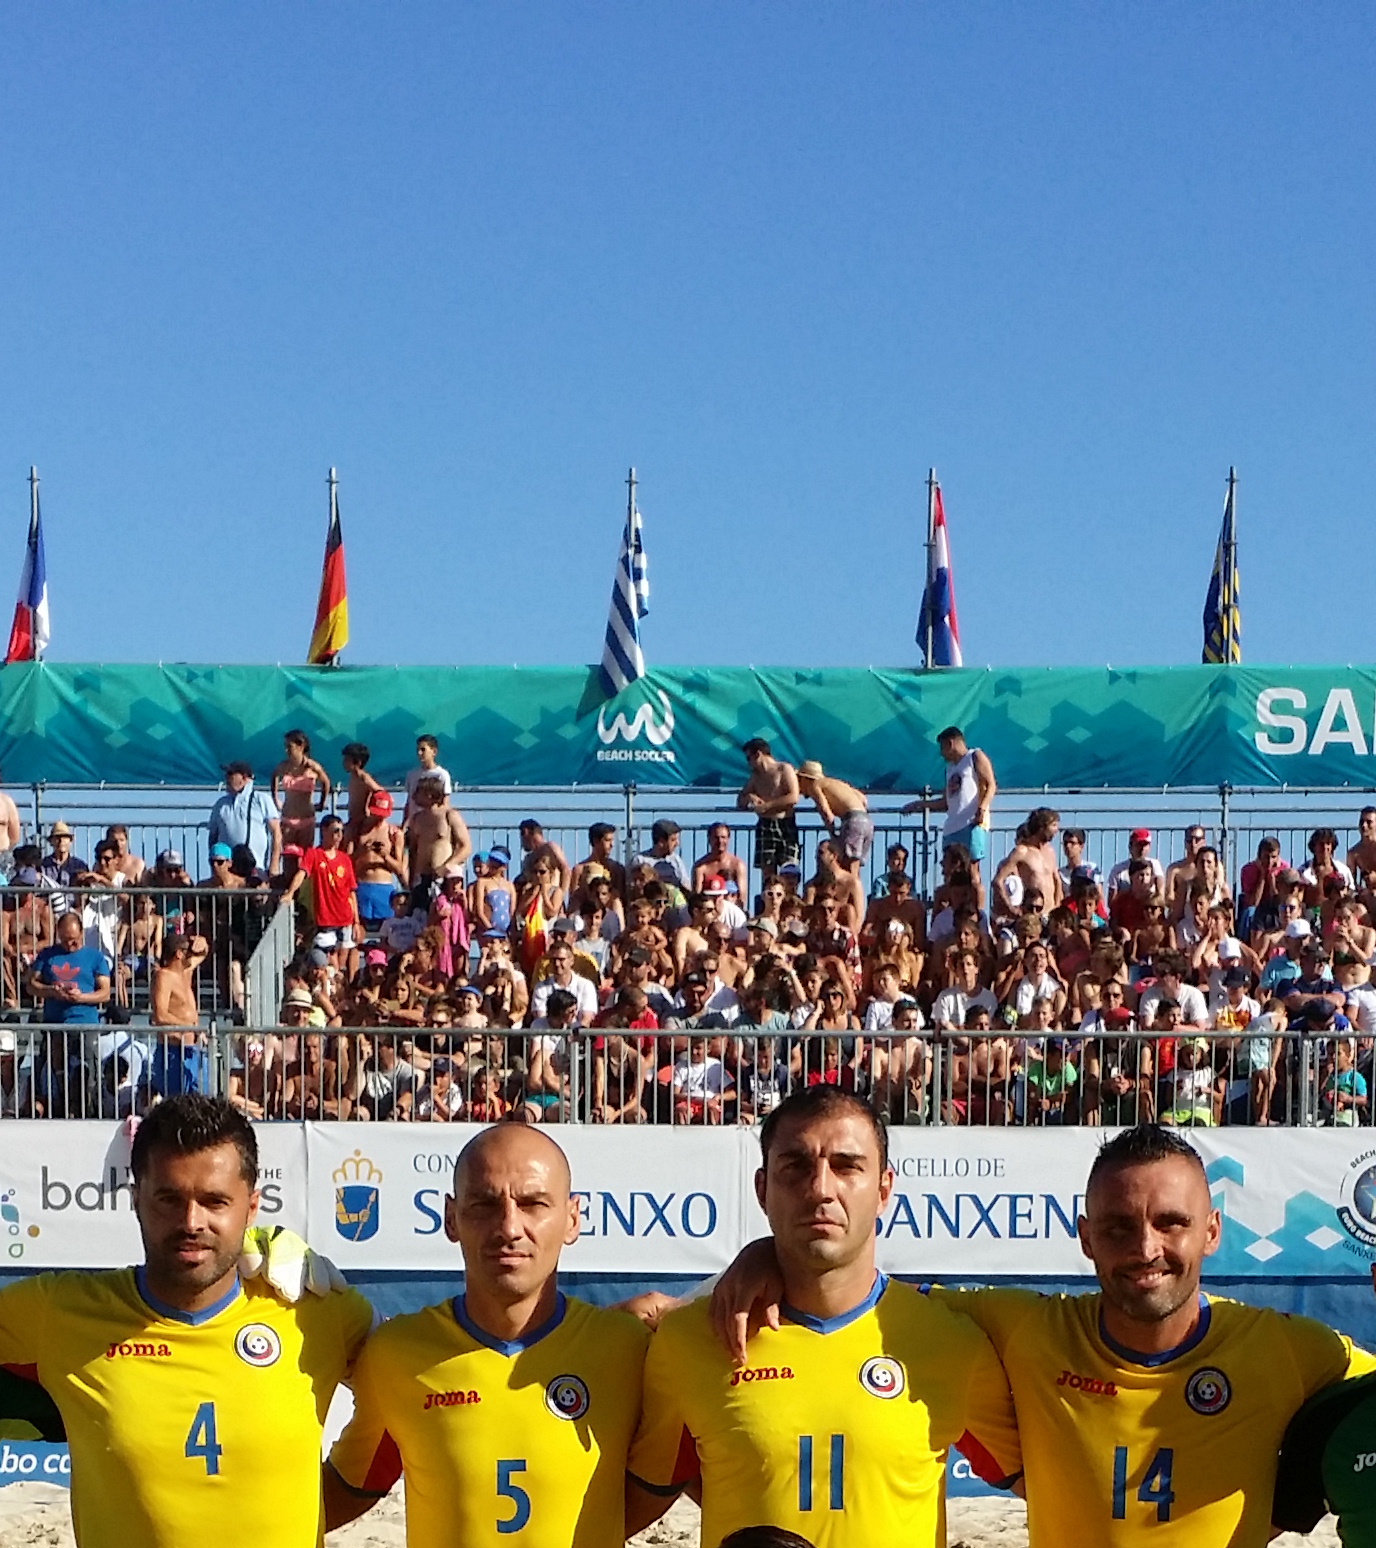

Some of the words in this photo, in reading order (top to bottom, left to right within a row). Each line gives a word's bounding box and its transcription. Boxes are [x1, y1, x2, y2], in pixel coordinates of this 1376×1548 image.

[597, 750, 633, 761] BEACH
[976, 1157, 1005, 1178] DE
[1350, 1149, 1376, 1169] BEACH
[875, 1192, 1085, 1239] ANXEN
[0, 1445, 38, 1474] bo
[184, 1401, 223, 1476] 4
[798, 1433, 845, 1512] 11
[1111, 1445, 1175, 1522] 14
[495, 1459, 531, 1534] 5
